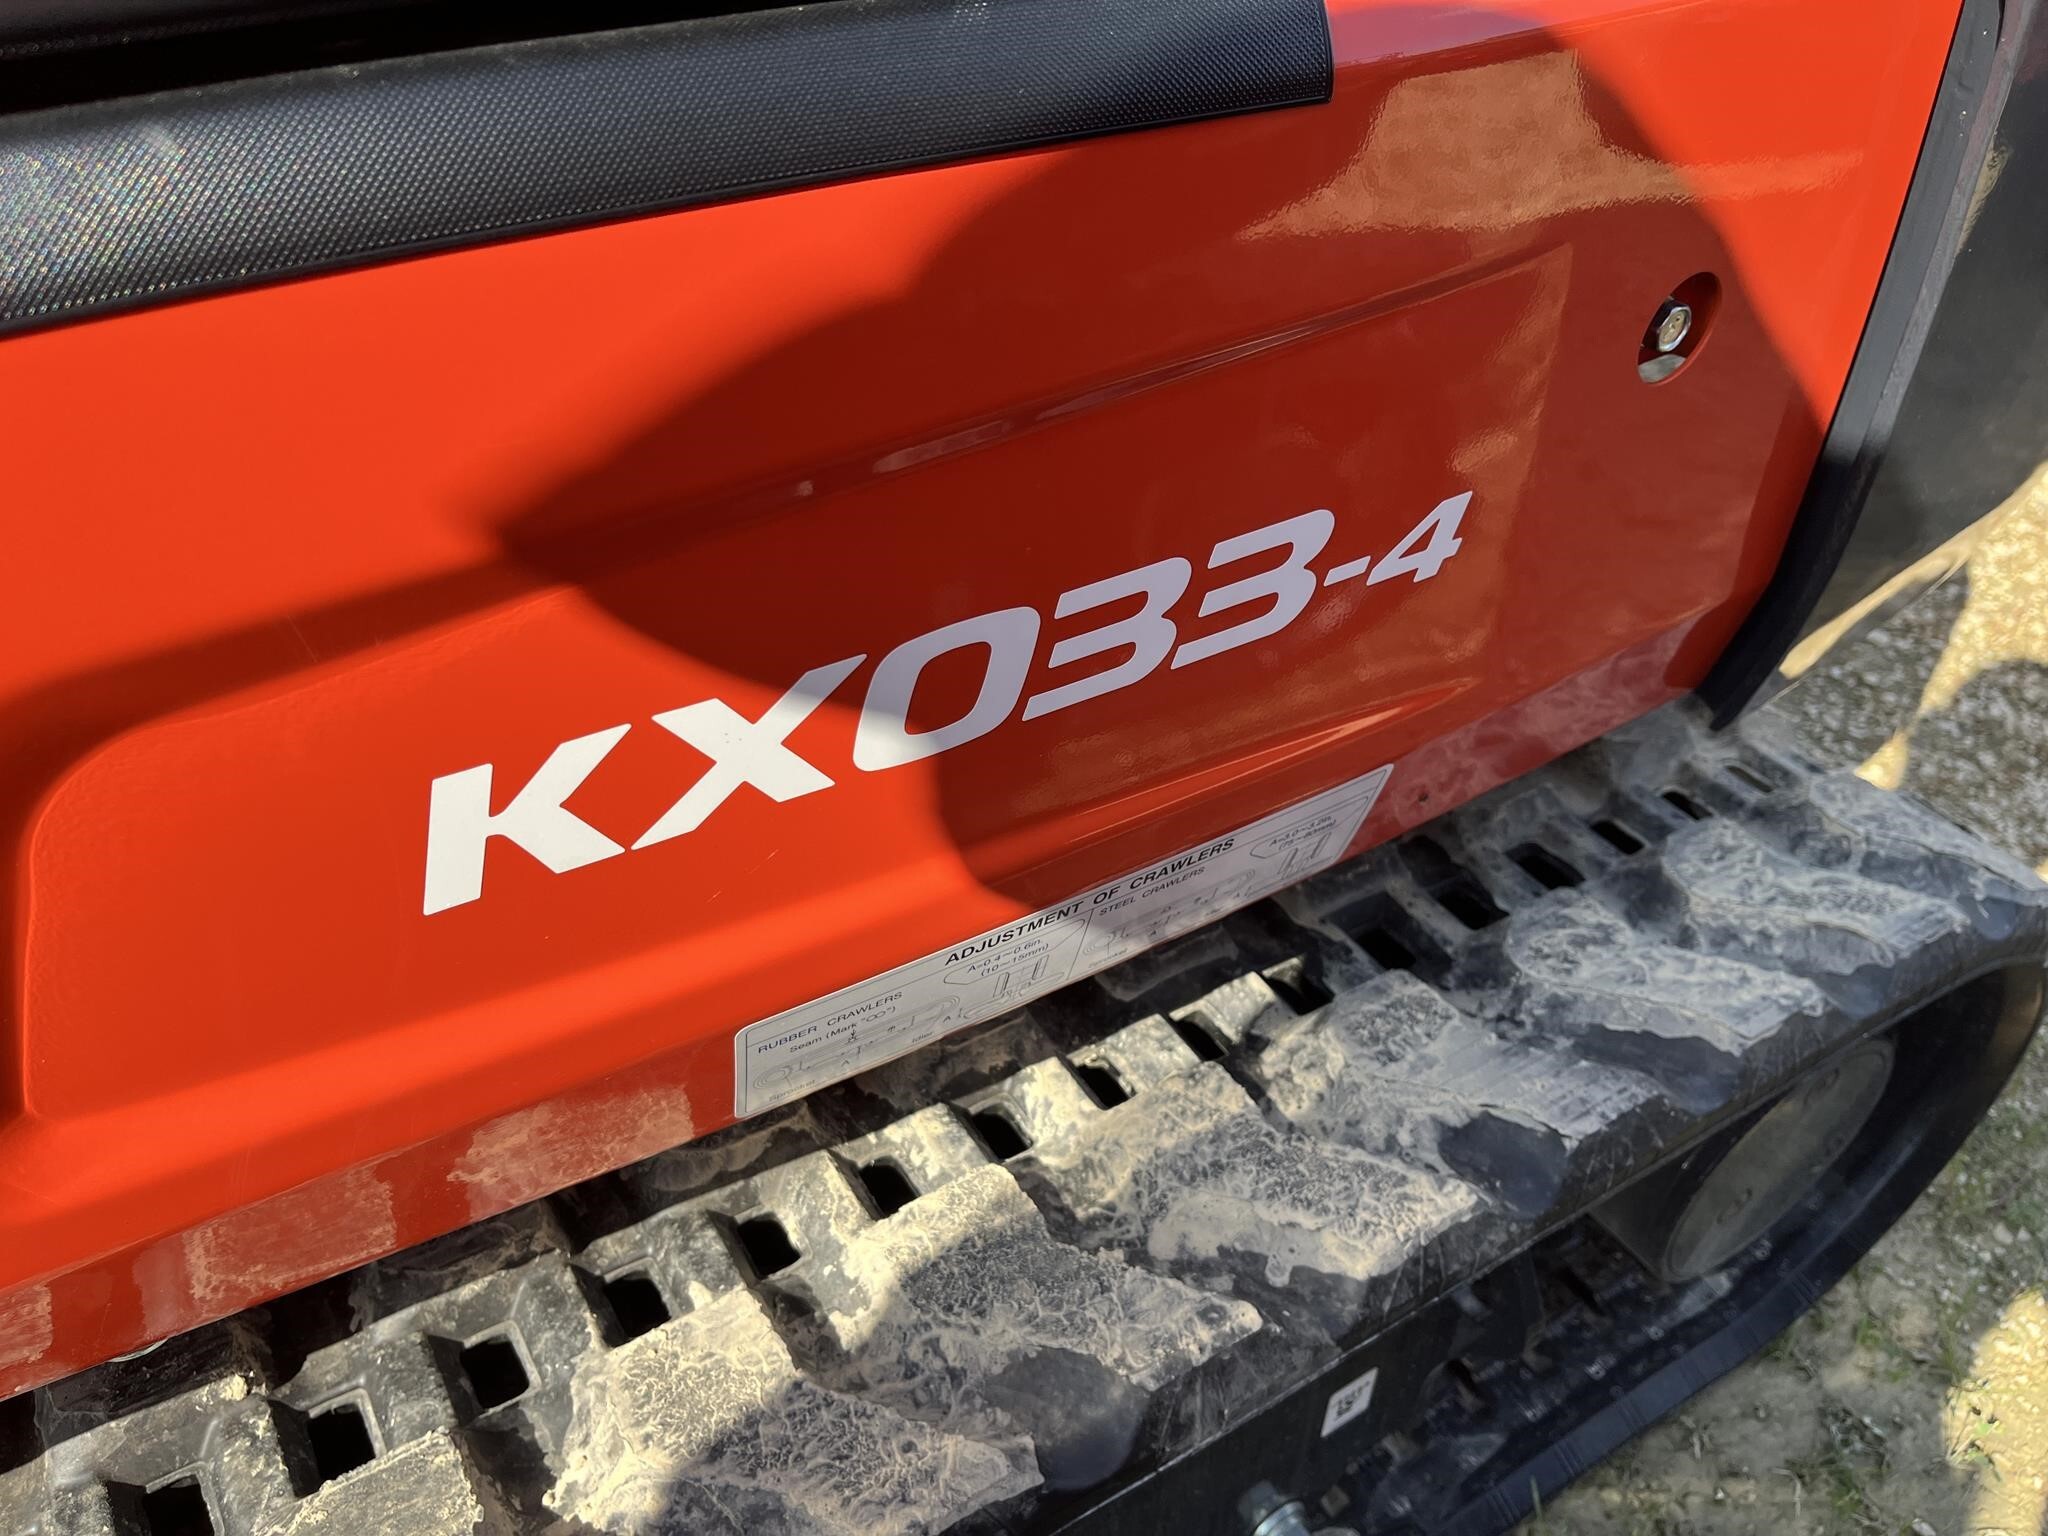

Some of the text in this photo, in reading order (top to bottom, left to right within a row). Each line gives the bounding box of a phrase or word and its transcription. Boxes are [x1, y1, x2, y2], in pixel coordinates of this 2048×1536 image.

[422, 491, 1472, 916] KX033-4
[945, 901, 1084, 965] ADJUSTMENT
[1093, 885, 1121, 905] OF
[1130, 838, 1235, 890] CRAWLERS
[1099, 866, 1205, 916] STEEL CRAWLERS
[758, 991, 902, 1054] RUBBER CRAWLERS
[790, 1035, 822, 1053] Seam
